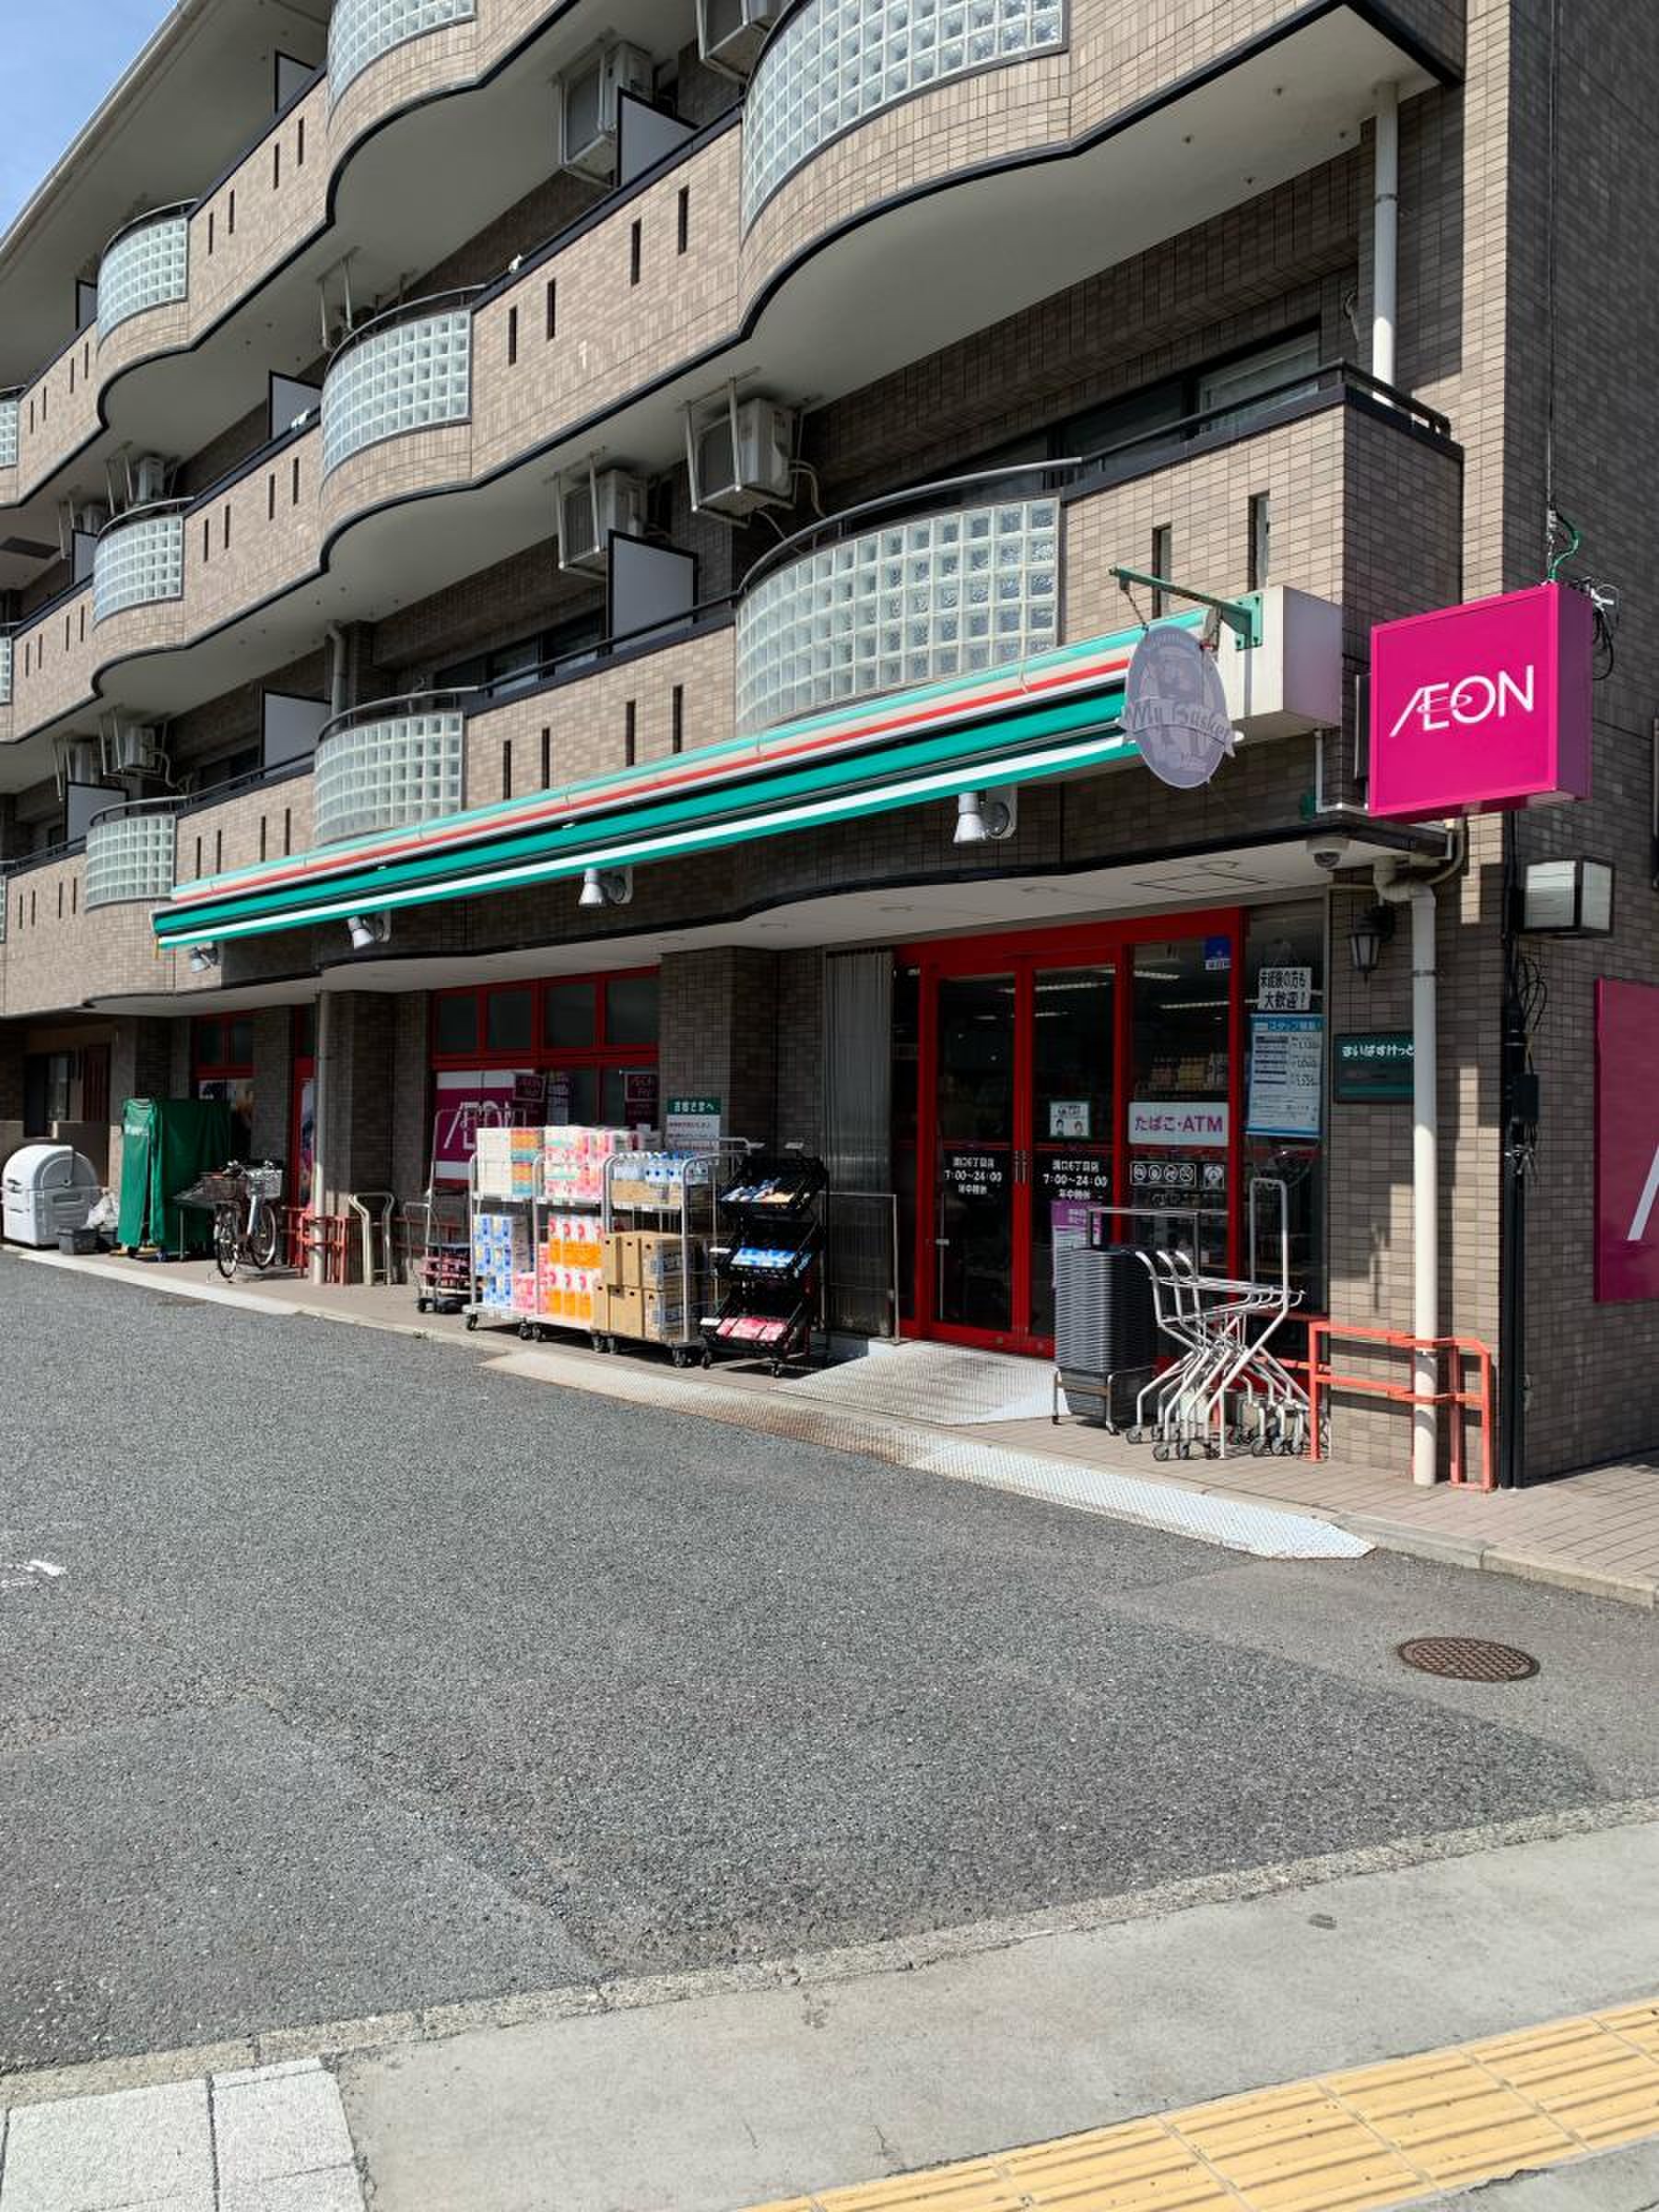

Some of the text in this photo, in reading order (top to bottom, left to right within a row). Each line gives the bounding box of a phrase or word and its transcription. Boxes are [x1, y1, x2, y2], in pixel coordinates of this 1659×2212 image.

[1342, 1043, 1417, 1058] まいばすけっと
